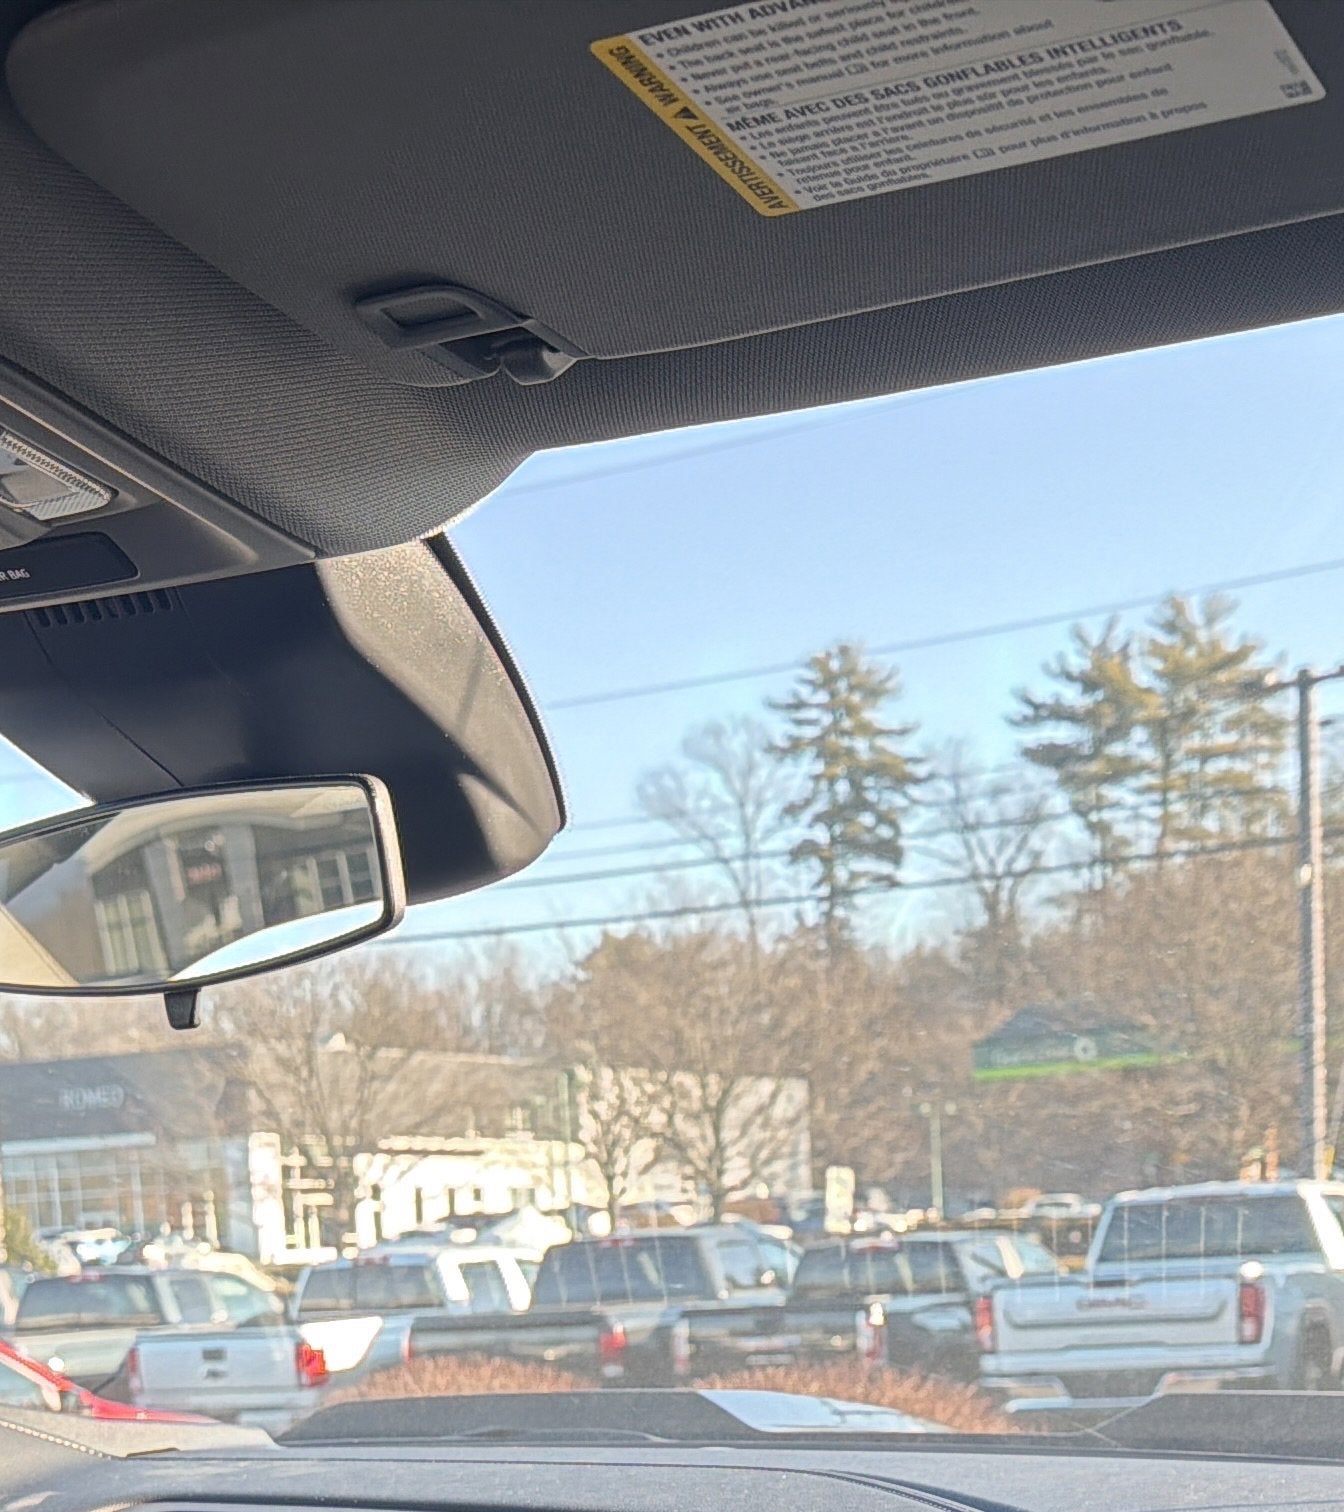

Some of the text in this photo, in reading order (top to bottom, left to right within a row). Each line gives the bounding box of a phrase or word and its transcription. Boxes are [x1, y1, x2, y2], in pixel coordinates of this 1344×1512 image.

[638, 25, 691, 46] EVEN
[691, 12, 745, 32] WITH
[726, 19, 1183, 132] MÊME AVEC DES SACS GONFLABLES INTELLIGENTS
[608, 45, 789, 209] AVERTISSEMENT WARNING
[6, 568, 31, 581] BAG
